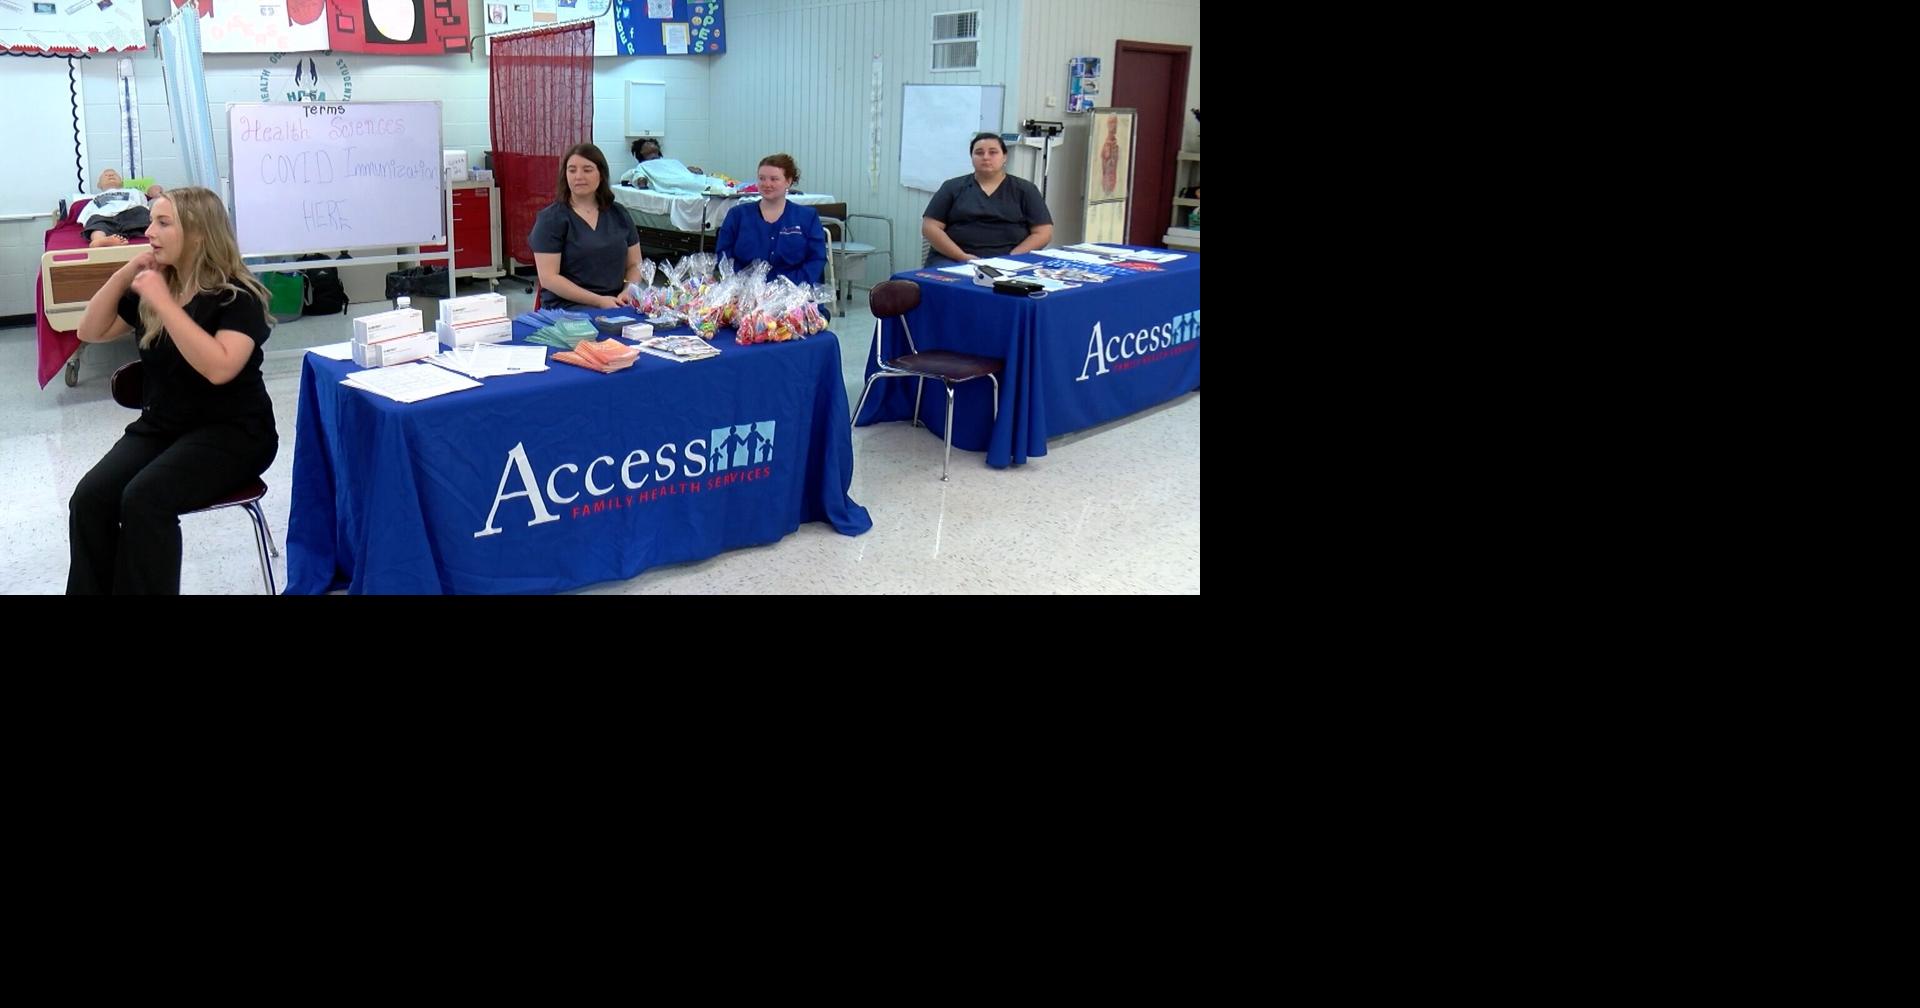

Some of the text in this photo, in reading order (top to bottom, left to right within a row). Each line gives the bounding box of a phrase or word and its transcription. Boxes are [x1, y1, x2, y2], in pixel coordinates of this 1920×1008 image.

[694, 0, 719, 53] YPES
[260, 69, 271, 102] EALTH
[240, 116, 406, 142] Health Sciences
[302, 105, 346, 118] Terms
[260, 150, 334, 185] COVID
[343, 146, 437, 179] Immunization
[302, 199, 353, 233] HERE
[1076, 320, 1172, 382] Access
[474, 438, 707, 538] Access
[571, 467, 771, 520] FAMILY HEALTH SERVICES
